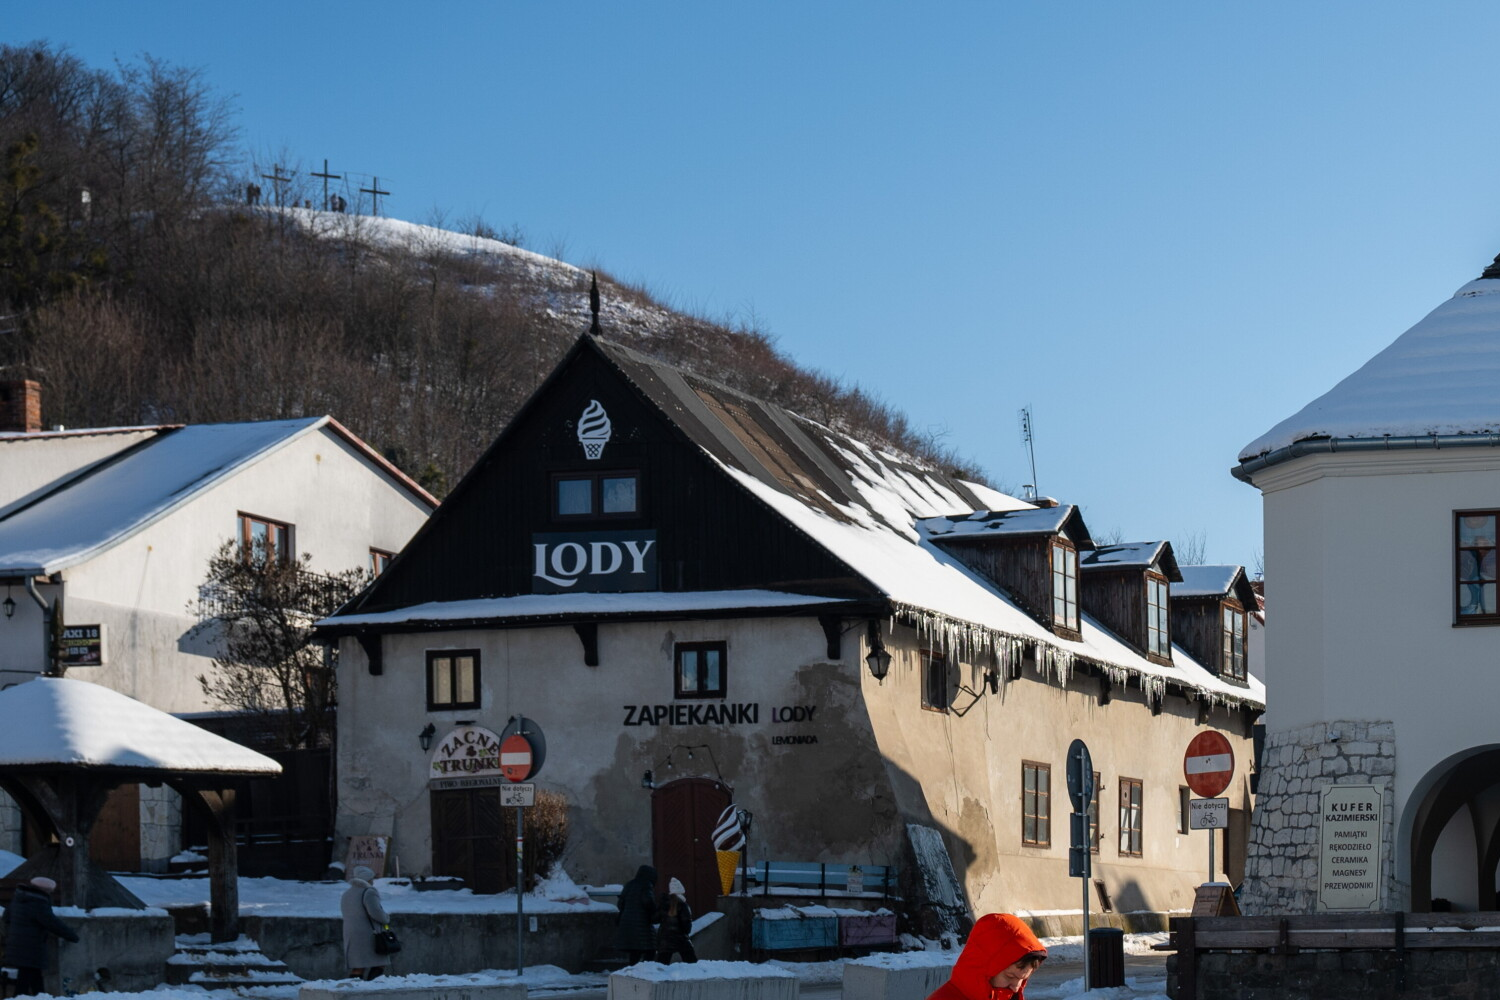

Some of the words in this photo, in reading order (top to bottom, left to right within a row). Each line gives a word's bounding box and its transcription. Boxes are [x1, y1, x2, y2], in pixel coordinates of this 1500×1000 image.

[533, 540, 656, 587] LODY
[62, 629, 83, 638] AXI
[772, 705, 817, 723] LODY
[772, 735, 818, 746] LEMONIADA
[1192, 802, 1202, 810] Nie
[1204, 802, 1226, 811] dotyczy
[1331, 803, 1373, 812] KUFER
[1325, 814, 1378, 822] KAZIMIERSKI
[1334, 831, 1367, 839] PAMIĄTKI
[1329, 844, 1372, 852] RĘKODZIEŁO
[1331, 856, 1368, 864] CERAMIKA
[1332, 869, 1367, 877] MAGNESY
[1325, 882, 1373, 890] PRZEWODNIKI
